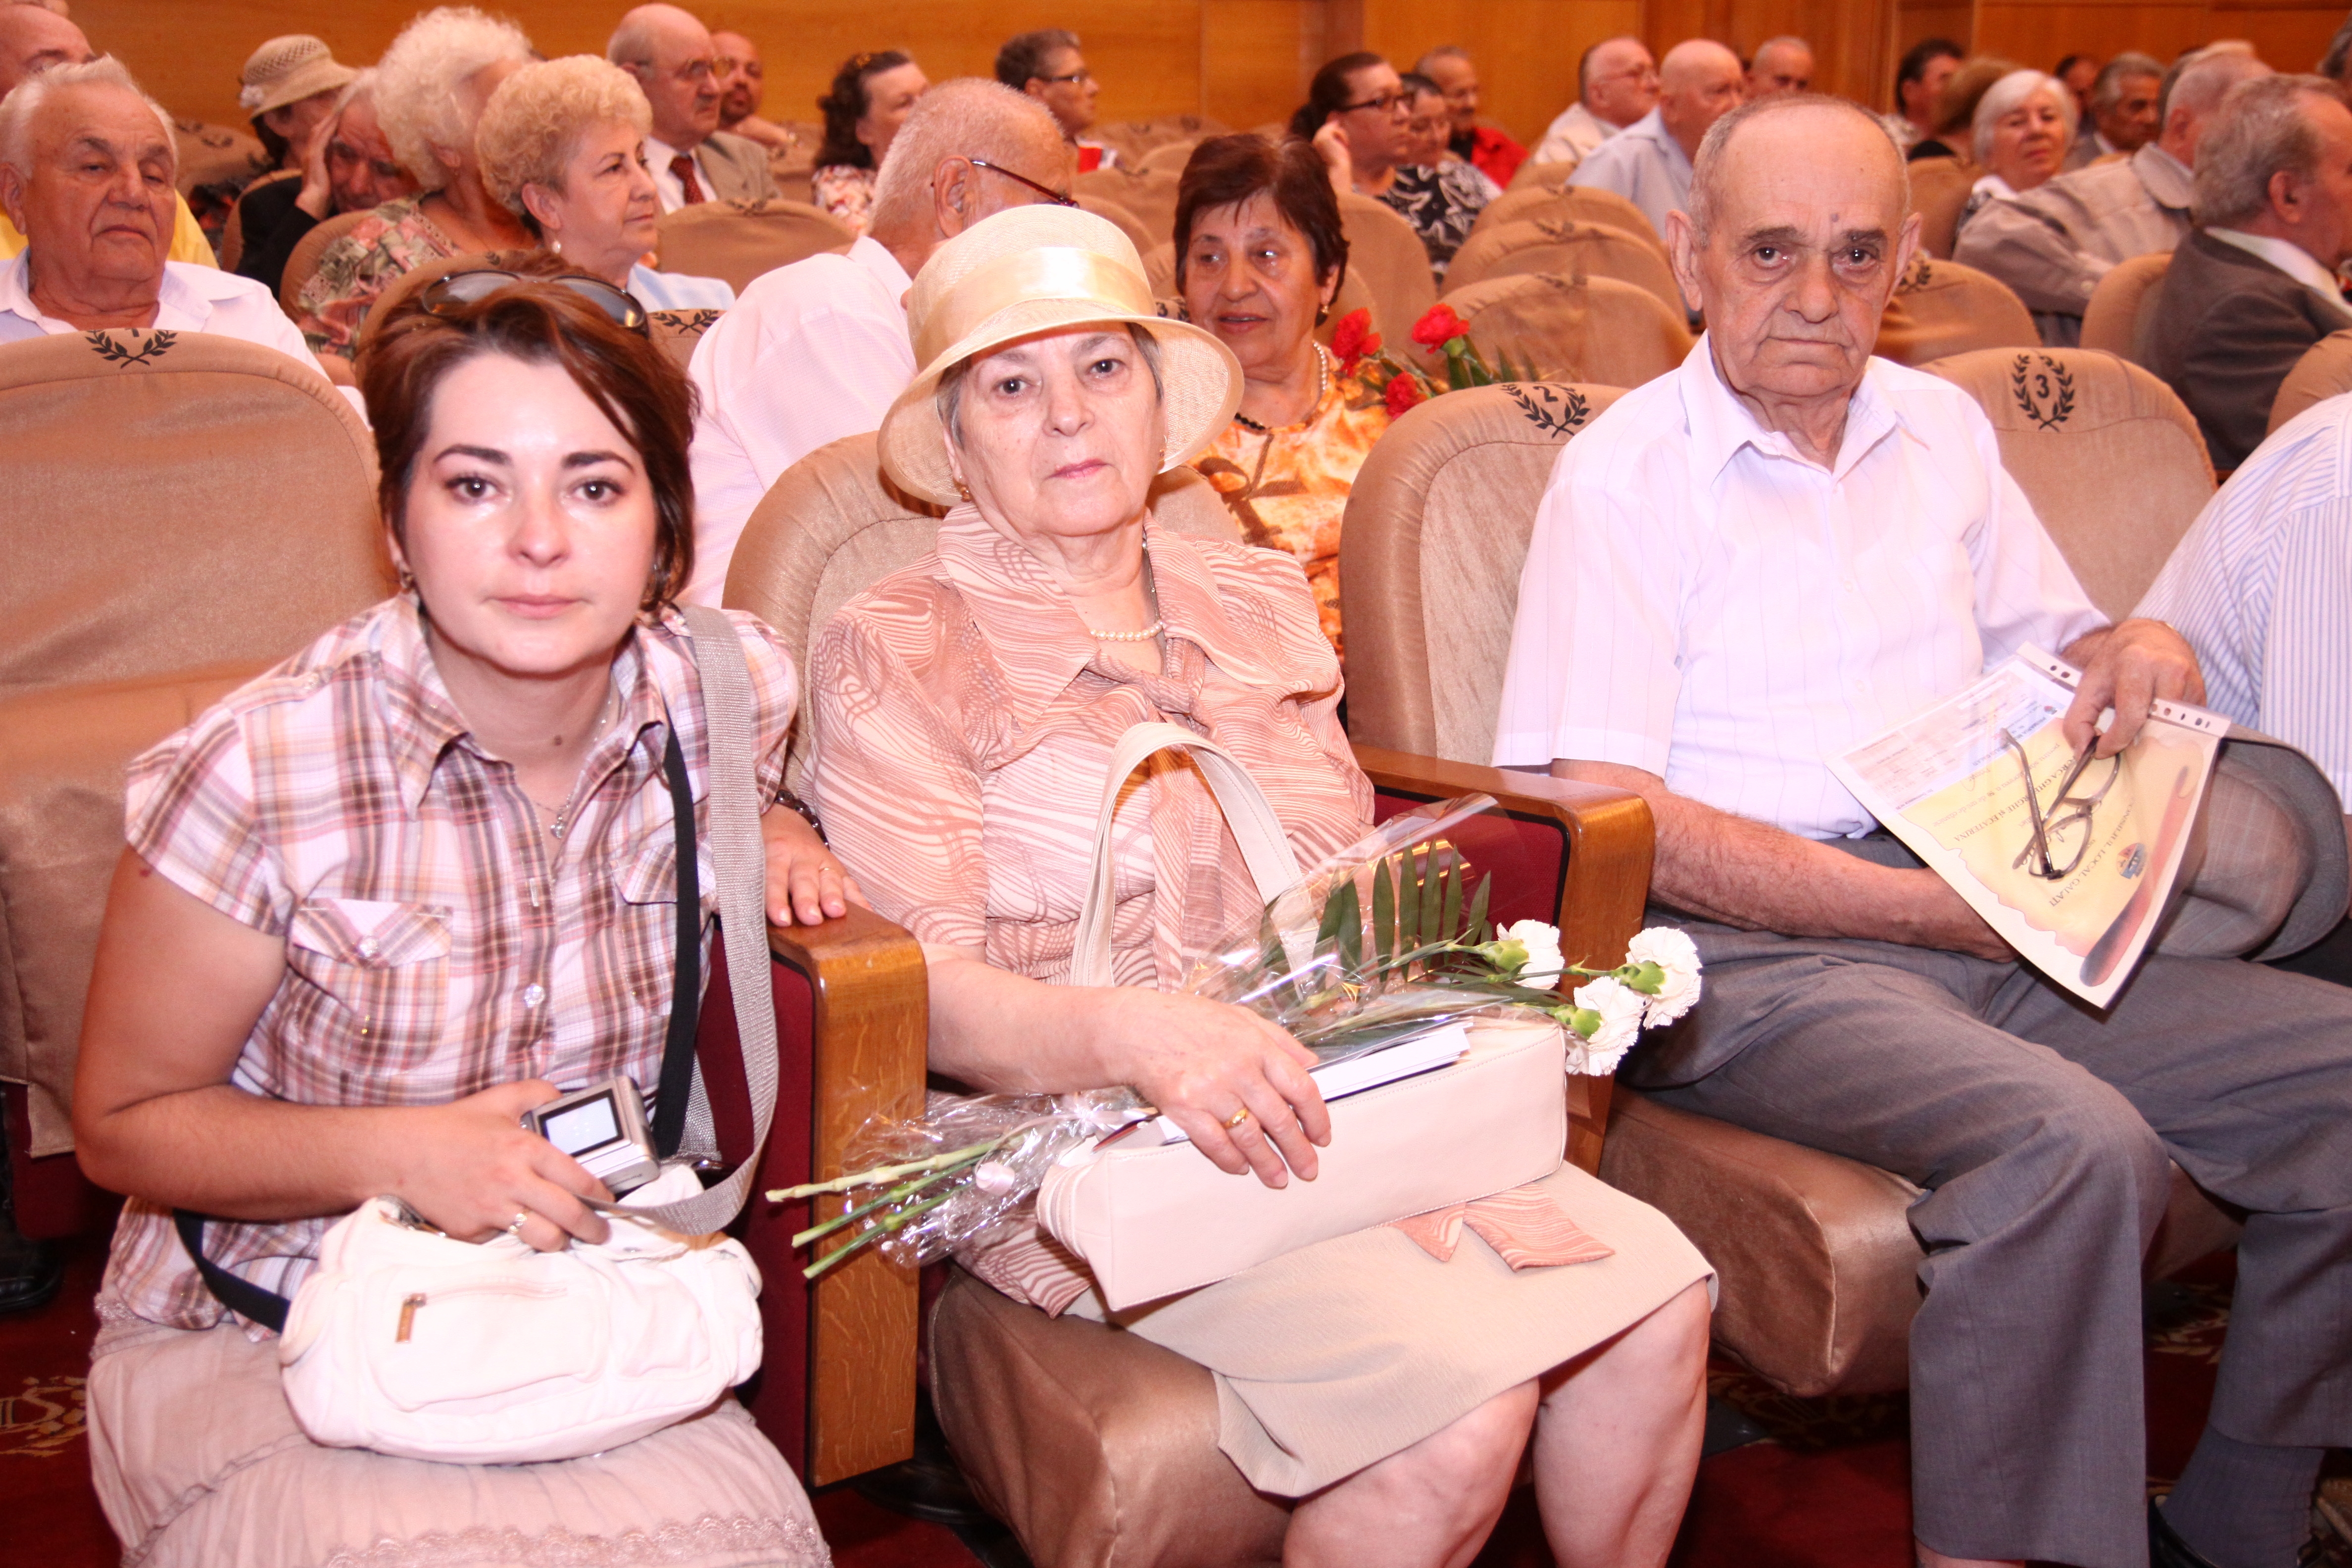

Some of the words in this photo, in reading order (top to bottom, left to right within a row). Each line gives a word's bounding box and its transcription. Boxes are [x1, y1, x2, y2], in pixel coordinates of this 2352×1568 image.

[1533, 386, 1558, 402] 2
[2035, 374, 2050, 398] 3
[2005, 778, 2051, 813] GHERGHE
[1954, 814, 1999, 842] ECATERINA
[2078, 848, 2106, 878] LOCAL
